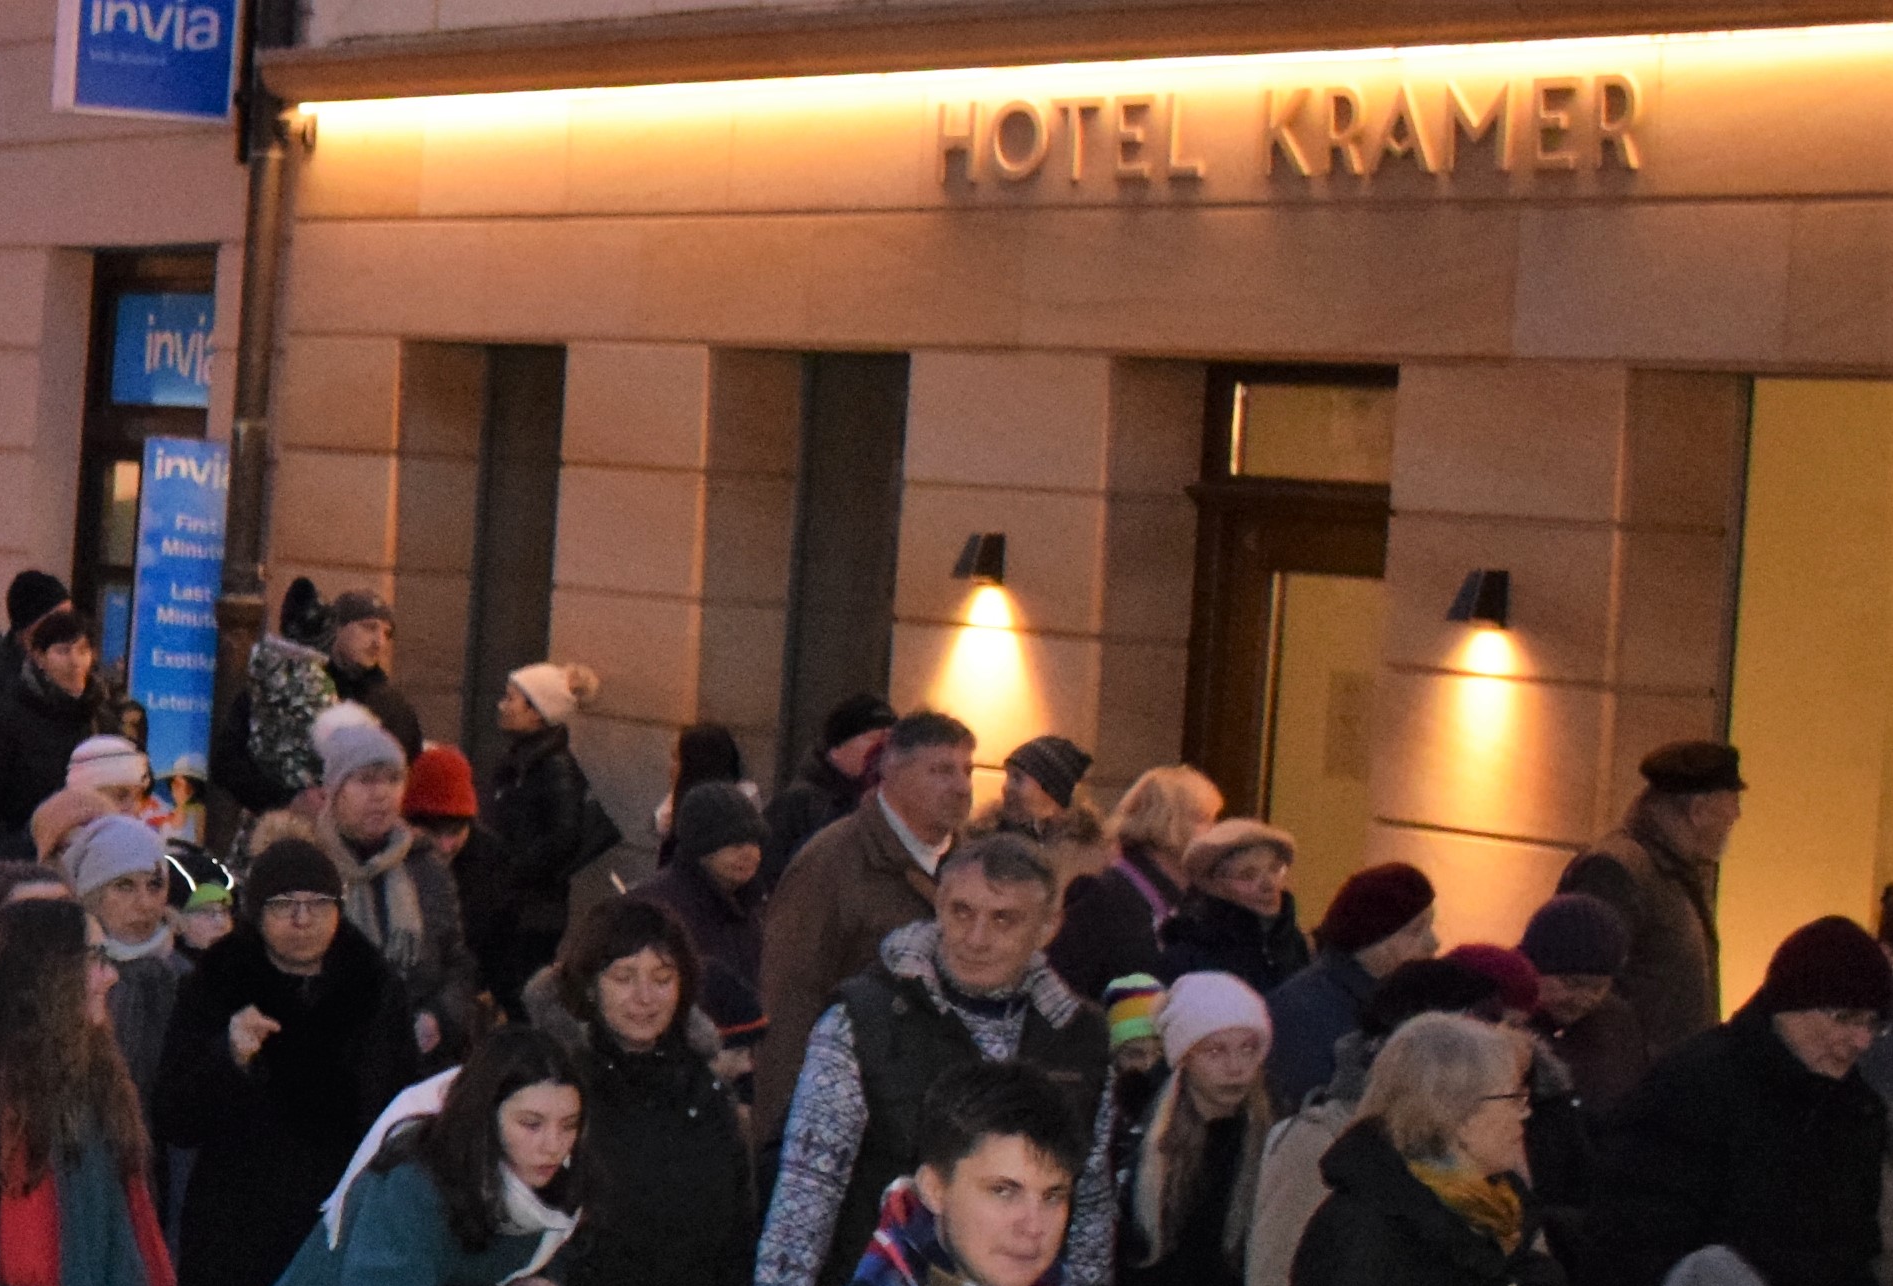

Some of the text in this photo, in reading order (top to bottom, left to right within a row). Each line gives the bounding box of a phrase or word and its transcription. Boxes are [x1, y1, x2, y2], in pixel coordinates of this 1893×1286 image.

[90, 0, 221, 51] invia
[938, 73, 1641, 186] HOTEL KRAMER
